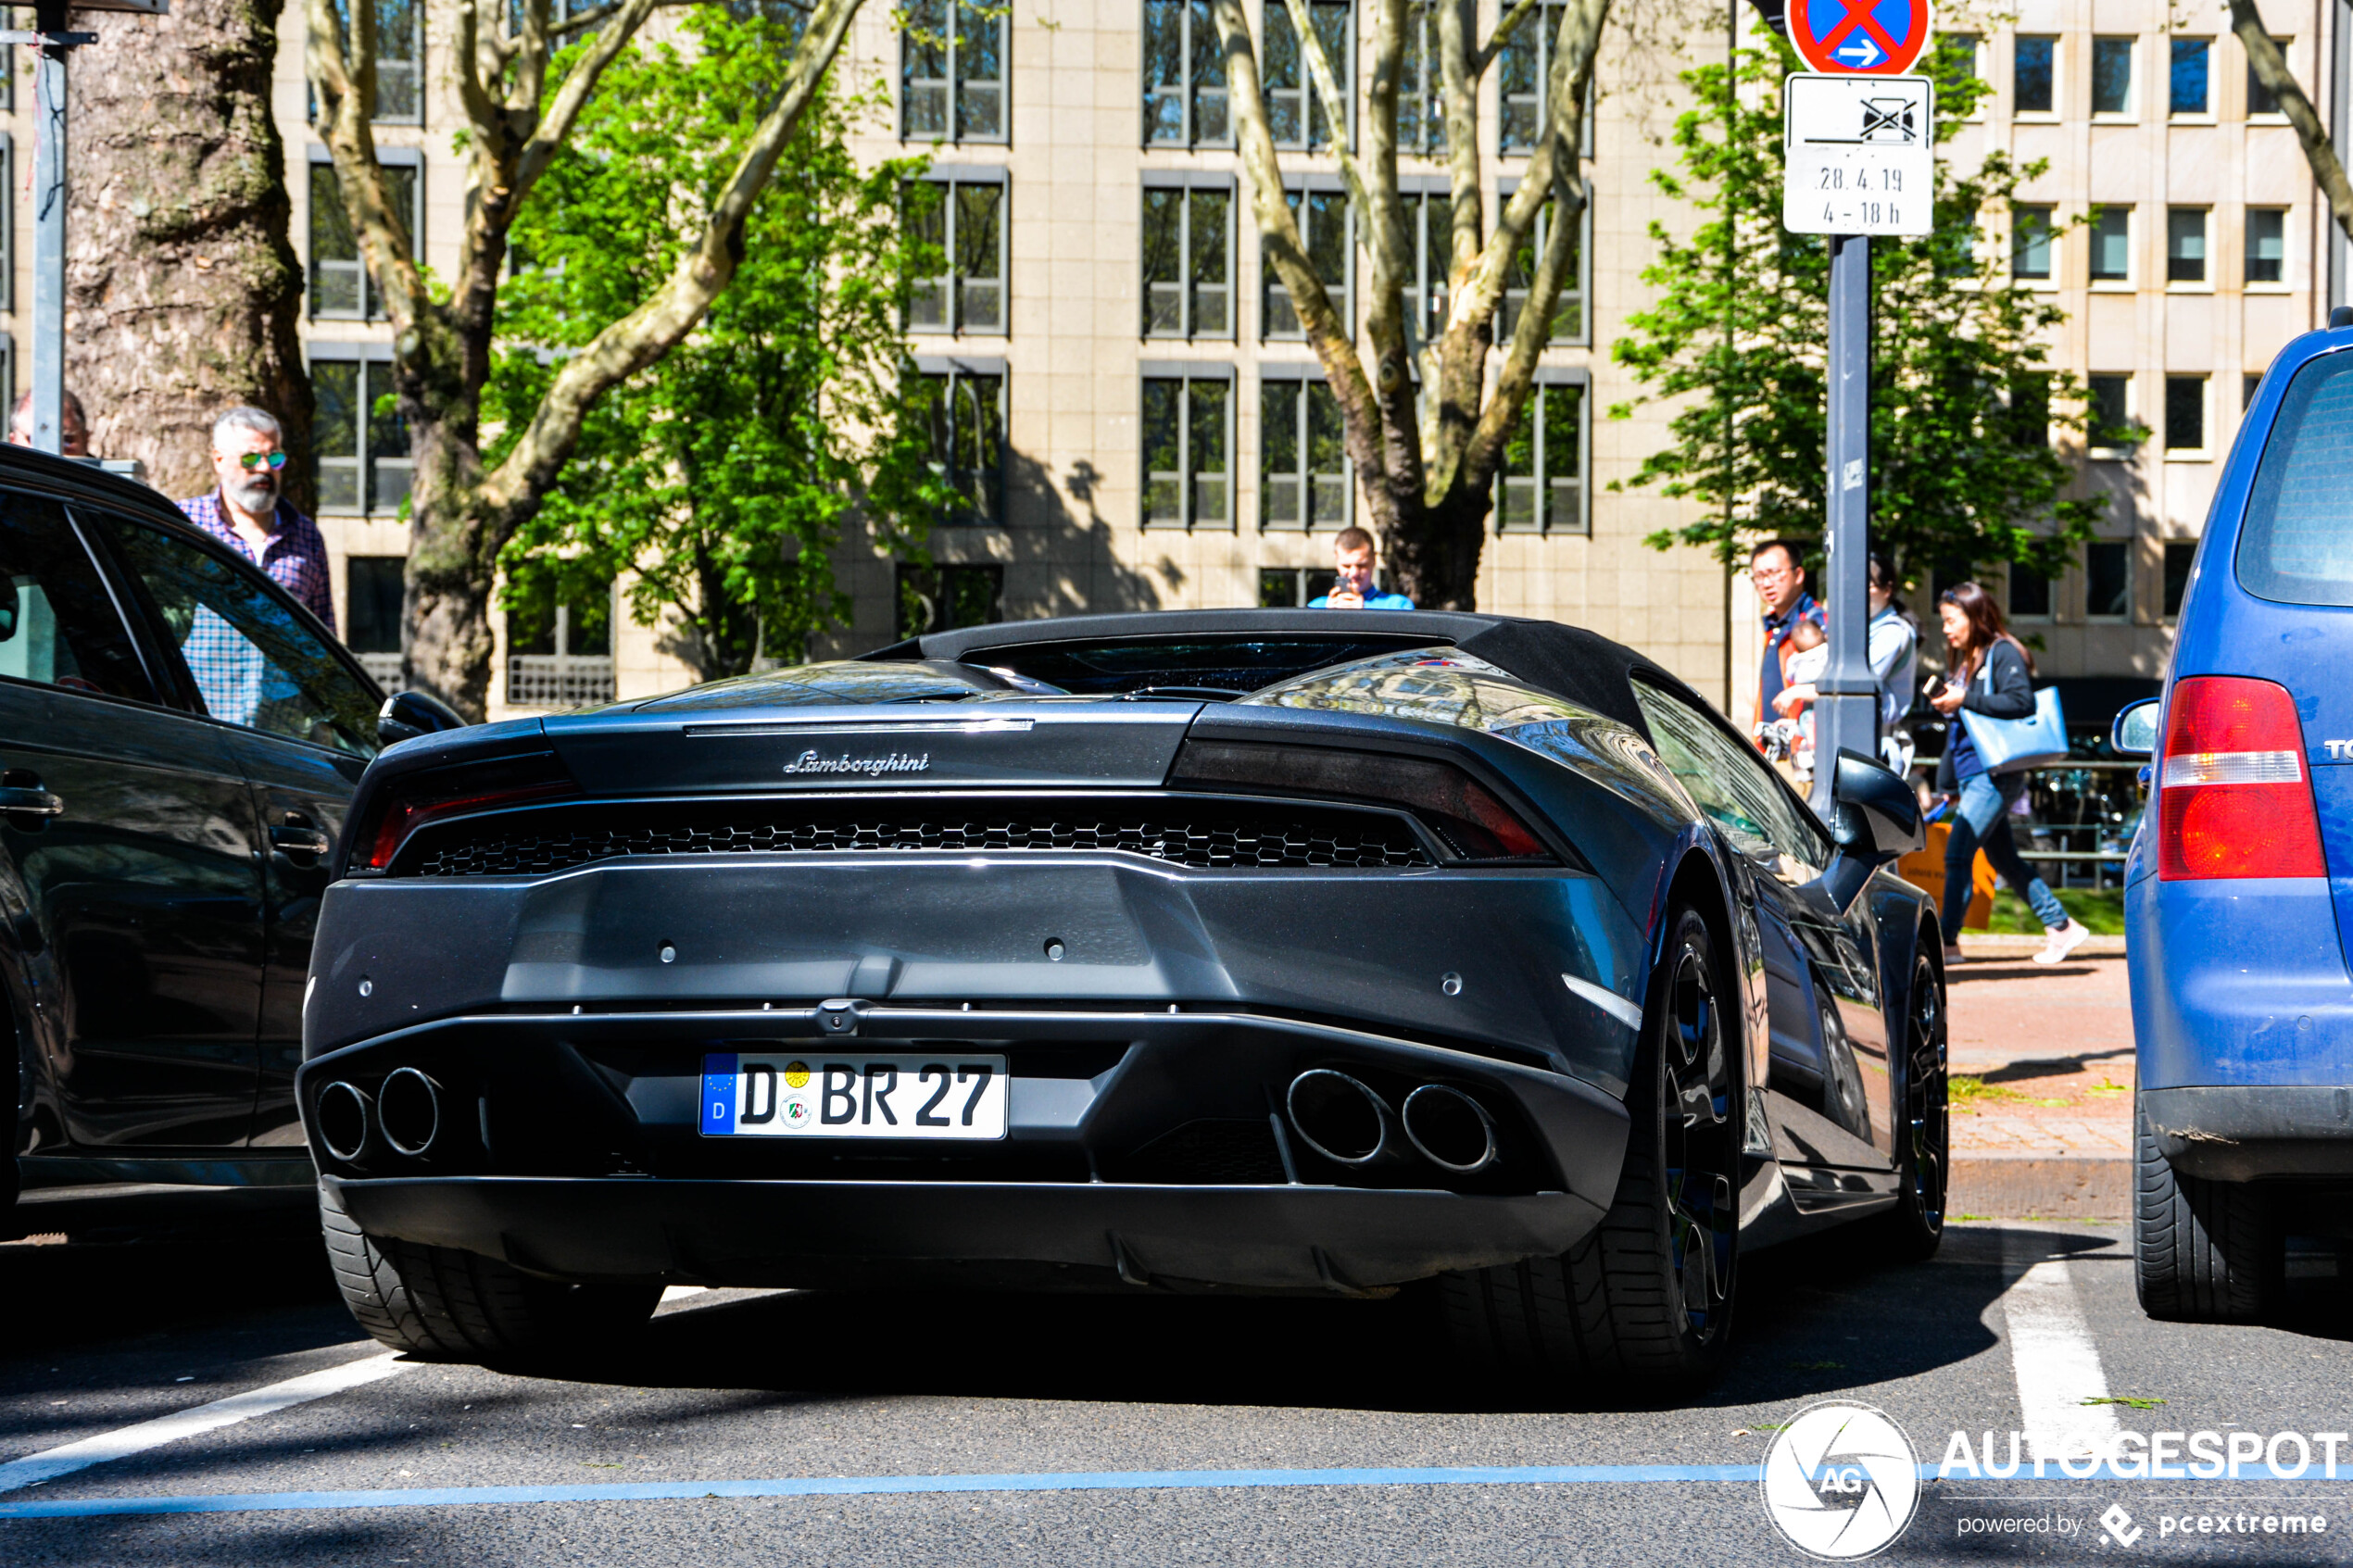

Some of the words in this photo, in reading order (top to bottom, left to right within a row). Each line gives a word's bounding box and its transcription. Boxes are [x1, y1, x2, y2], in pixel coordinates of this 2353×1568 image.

[1882, 169, 1902, 192] 19
[1823, 202, 1833, 223] 4
[1861, 202, 1880, 224] 18
[1890, 202, 1899, 224] h
[783, 749, 929, 777] Lamborghini
[741, 1063, 777, 1124] D
[821, 1063, 898, 1125] BR
[916, 1064, 993, 1126] 27
[712, 1102, 725, 1119] D
